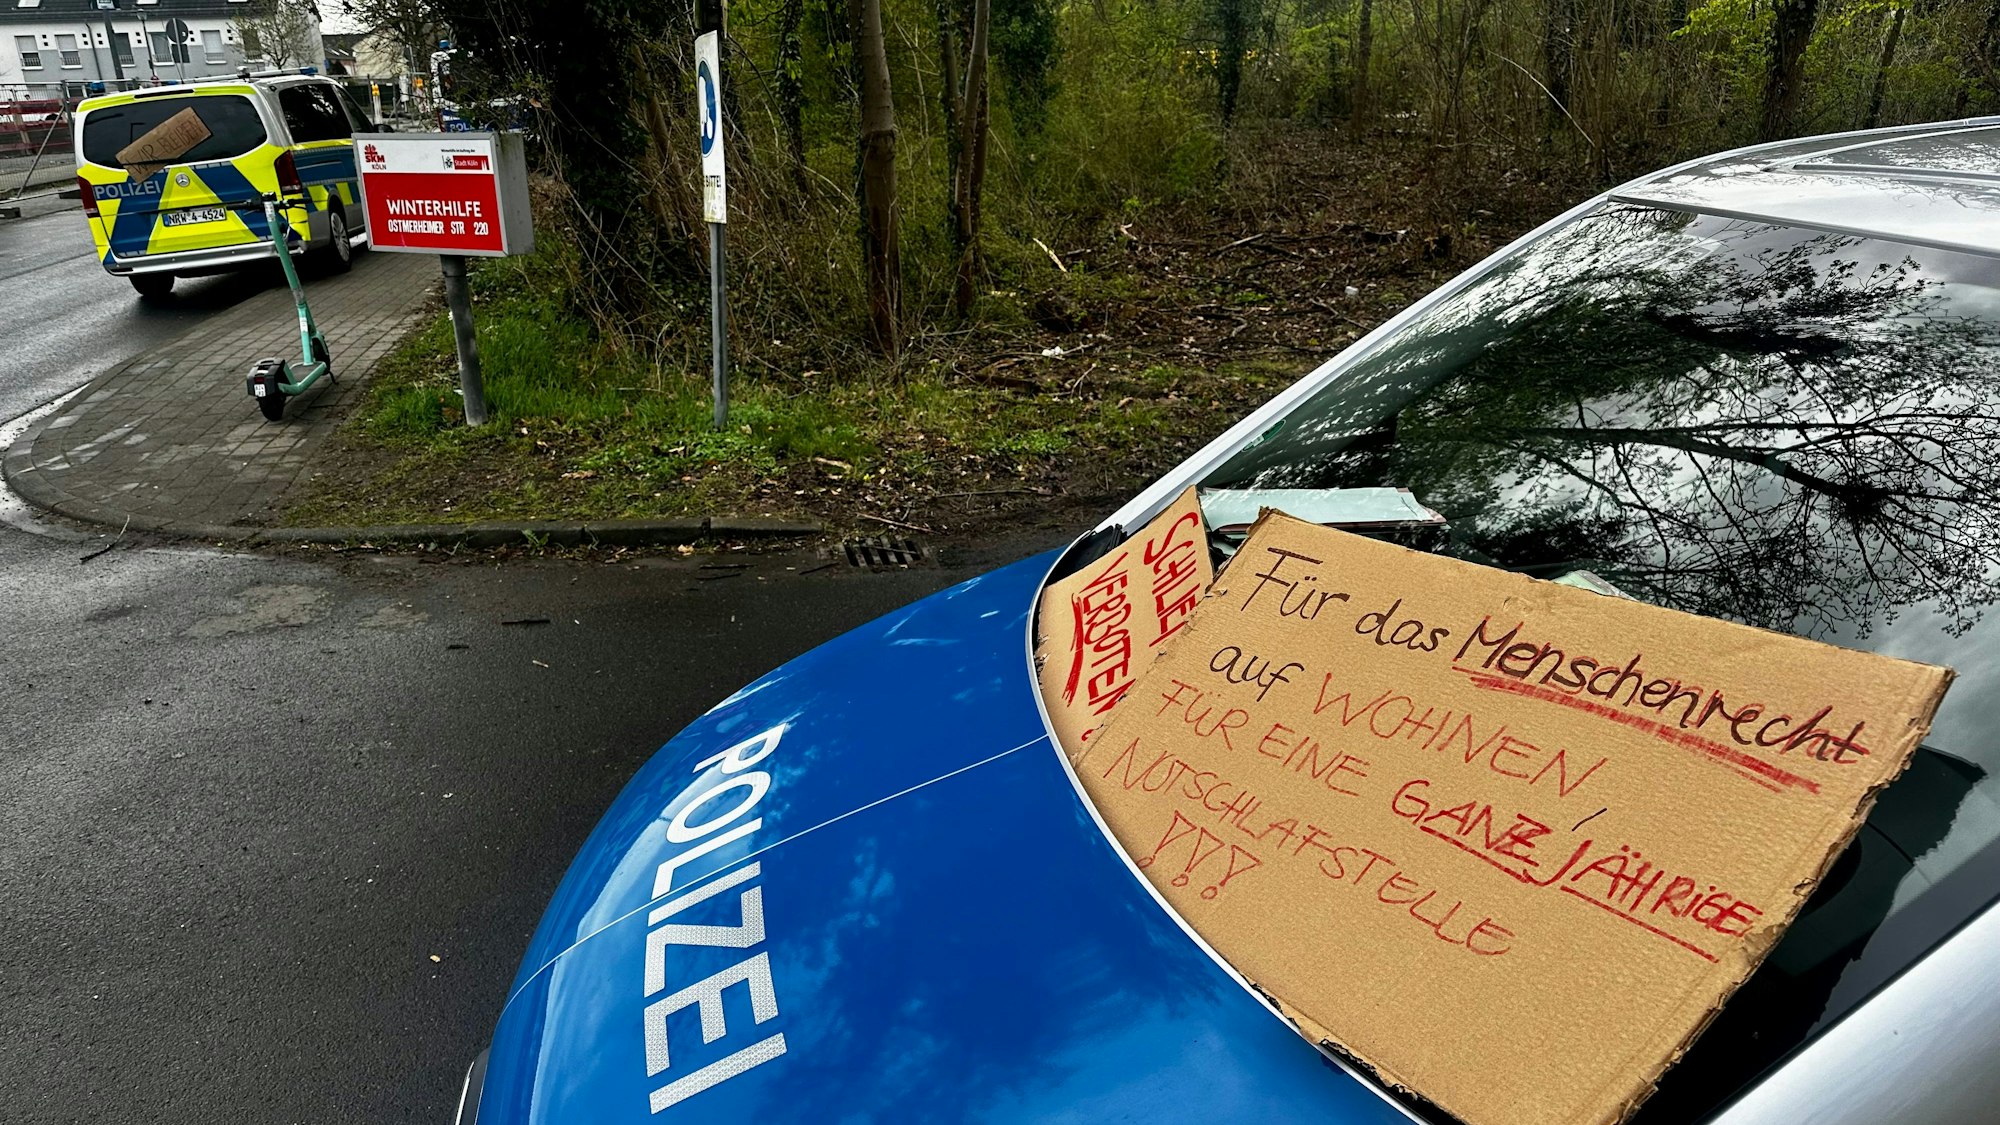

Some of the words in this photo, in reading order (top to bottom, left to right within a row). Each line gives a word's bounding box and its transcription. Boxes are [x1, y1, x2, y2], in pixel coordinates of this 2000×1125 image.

[365, 155, 385, 163] SKM
[94, 180, 161, 200] POLIZEI
[386, 199, 482, 218] WINTERHILFE
[387, 219, 445, 235] OSTMERHEIMER
[451, 220, 466, 235] STR
[473, 222, 489, 236] 220
[1210, 645, 1305, 702] auf
[1241, 547, 1350, 620] Für
[1355, 598, 1450, 652] das
[1455, 614, 1870, 764] Menschenrecht
[1156, 679, 1250, 752] FÜR
[1258, 723, 1371, 797] EINE
[1103, 737, 1516, 956] NOTSCHLAFSTELLE
[643, 722, 787, 1115] POLIZEI
